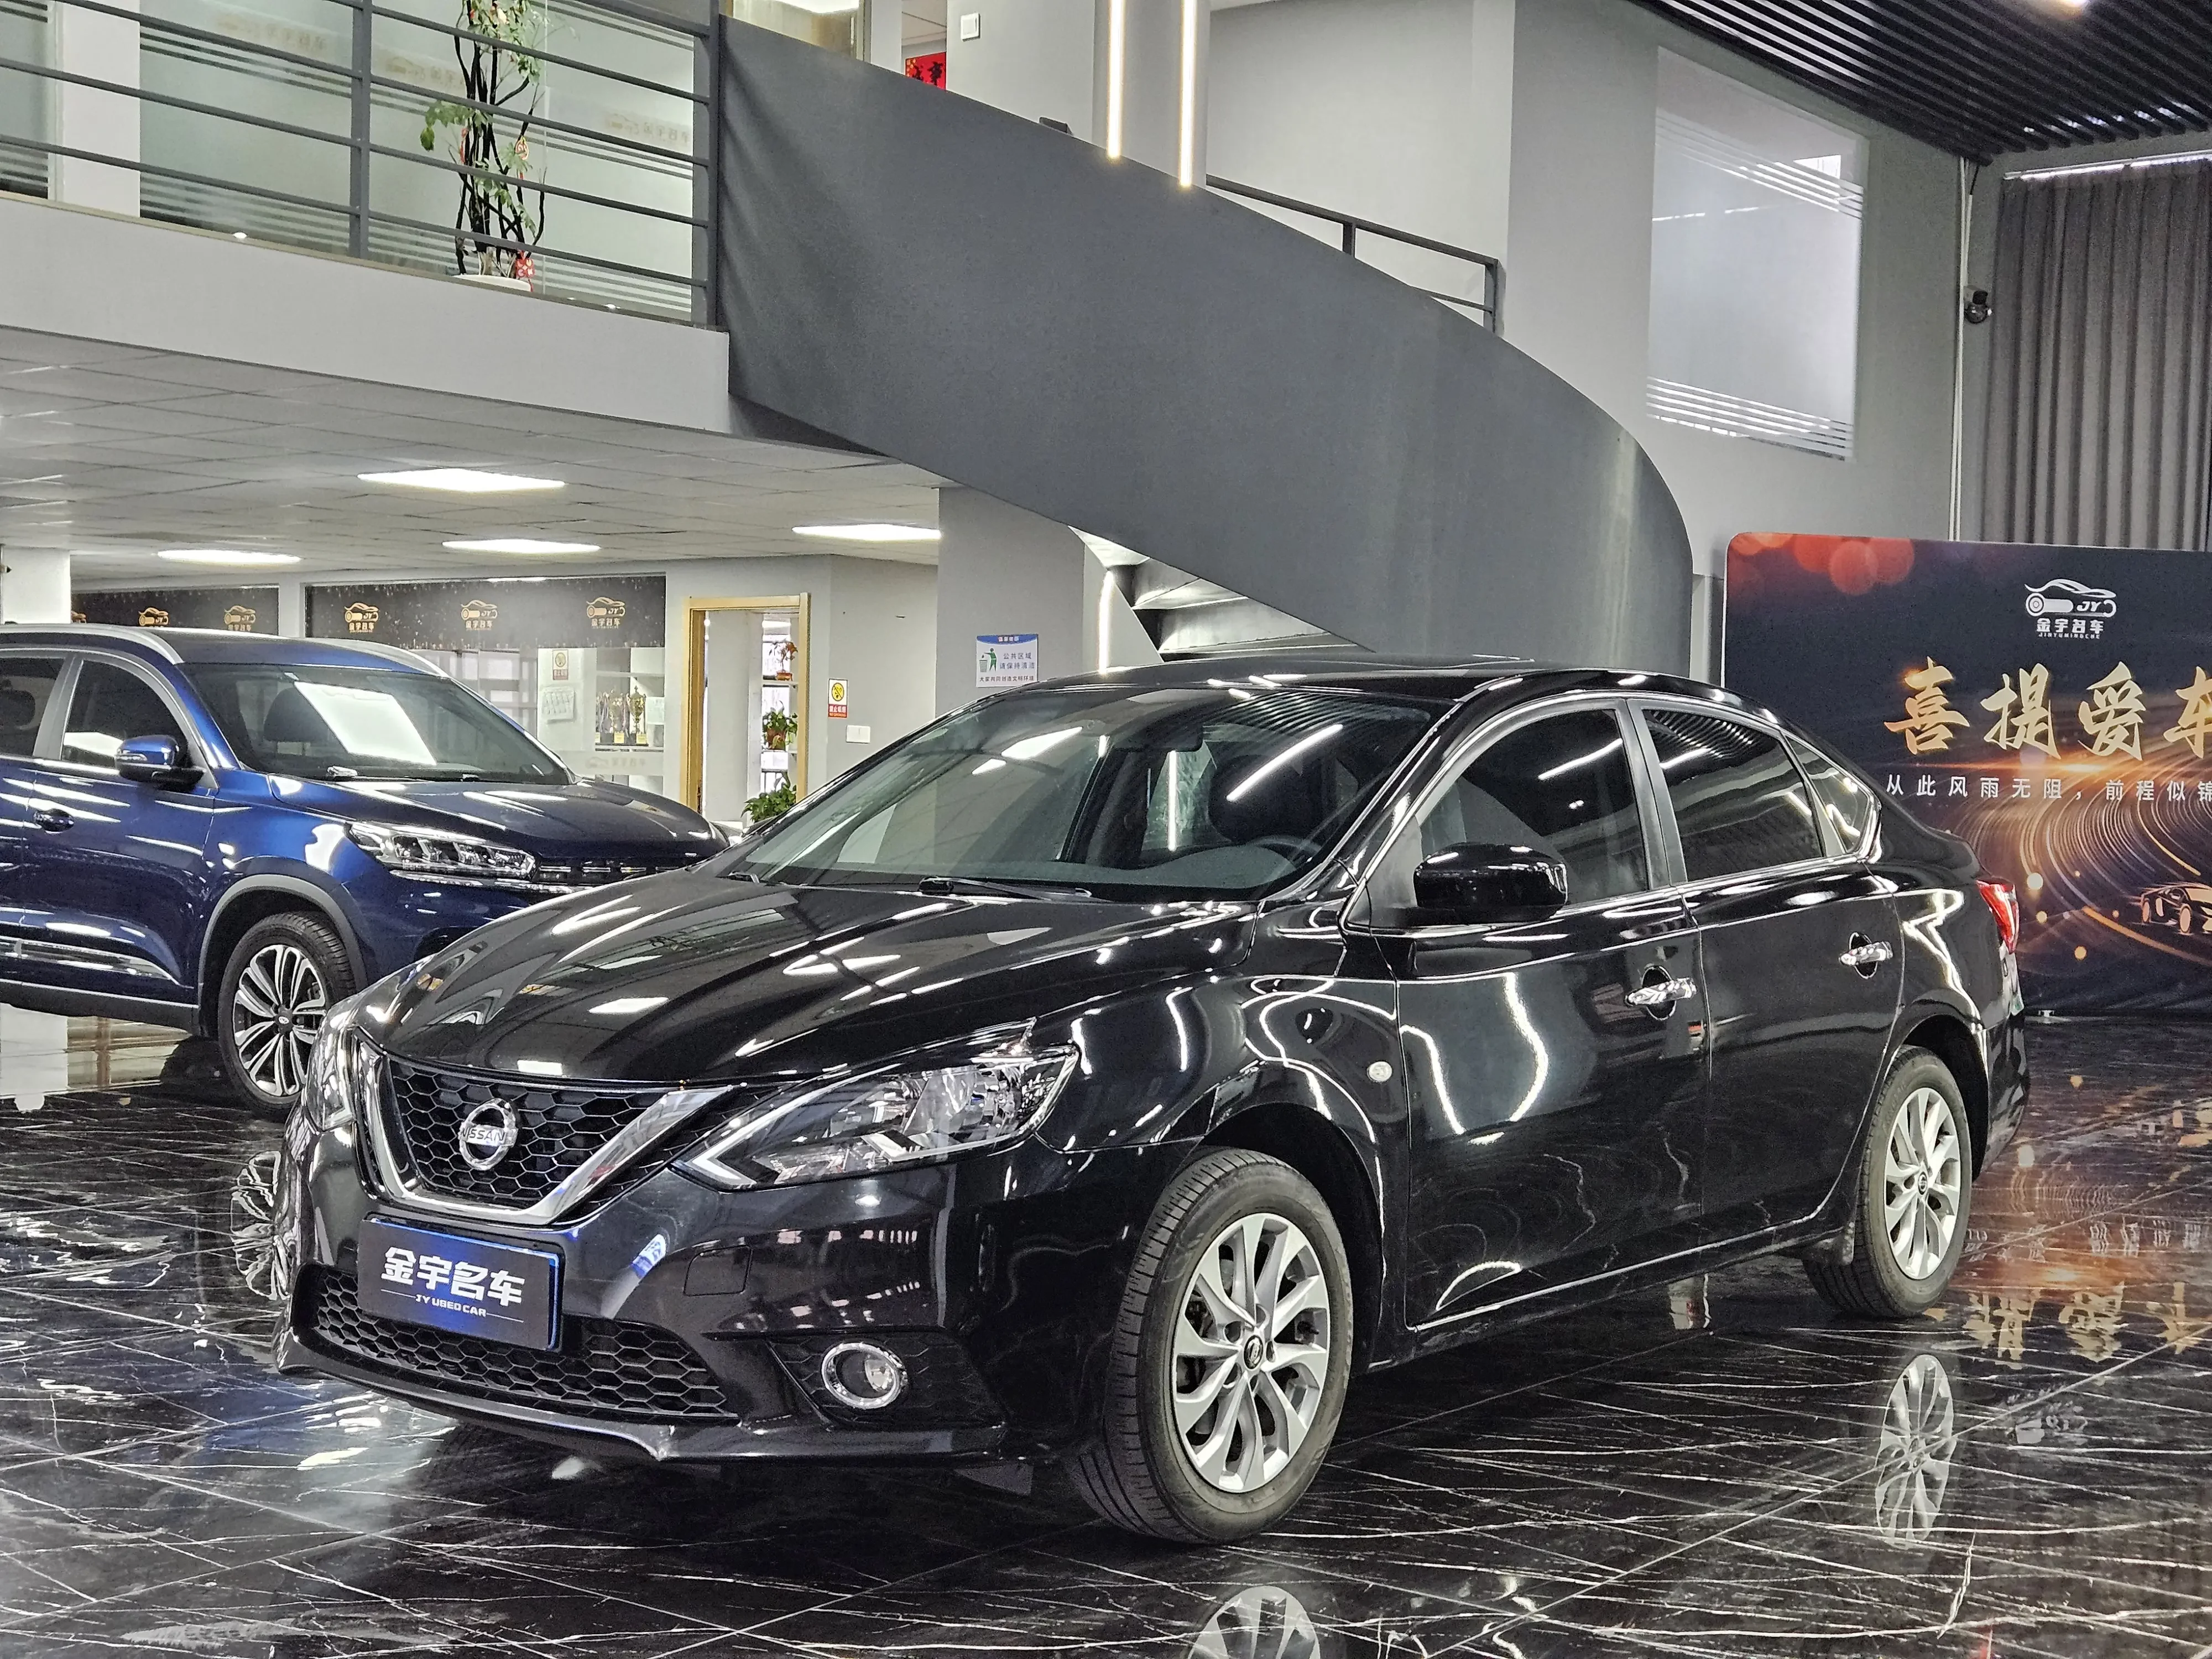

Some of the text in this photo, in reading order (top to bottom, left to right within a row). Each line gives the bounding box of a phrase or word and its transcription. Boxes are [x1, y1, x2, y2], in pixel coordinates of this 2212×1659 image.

[2077, 601, 2101, 612] JY
[2036, 618, 2104, 634] 金宇名车
[1884, 656, 2212, 761] 喜提爱车
[461, 1128, 505, 1141] NISSAN
[381, 1246, 525, 1306] 金宇名车
[415, 1294, 487, 1317] JY USED CAR
